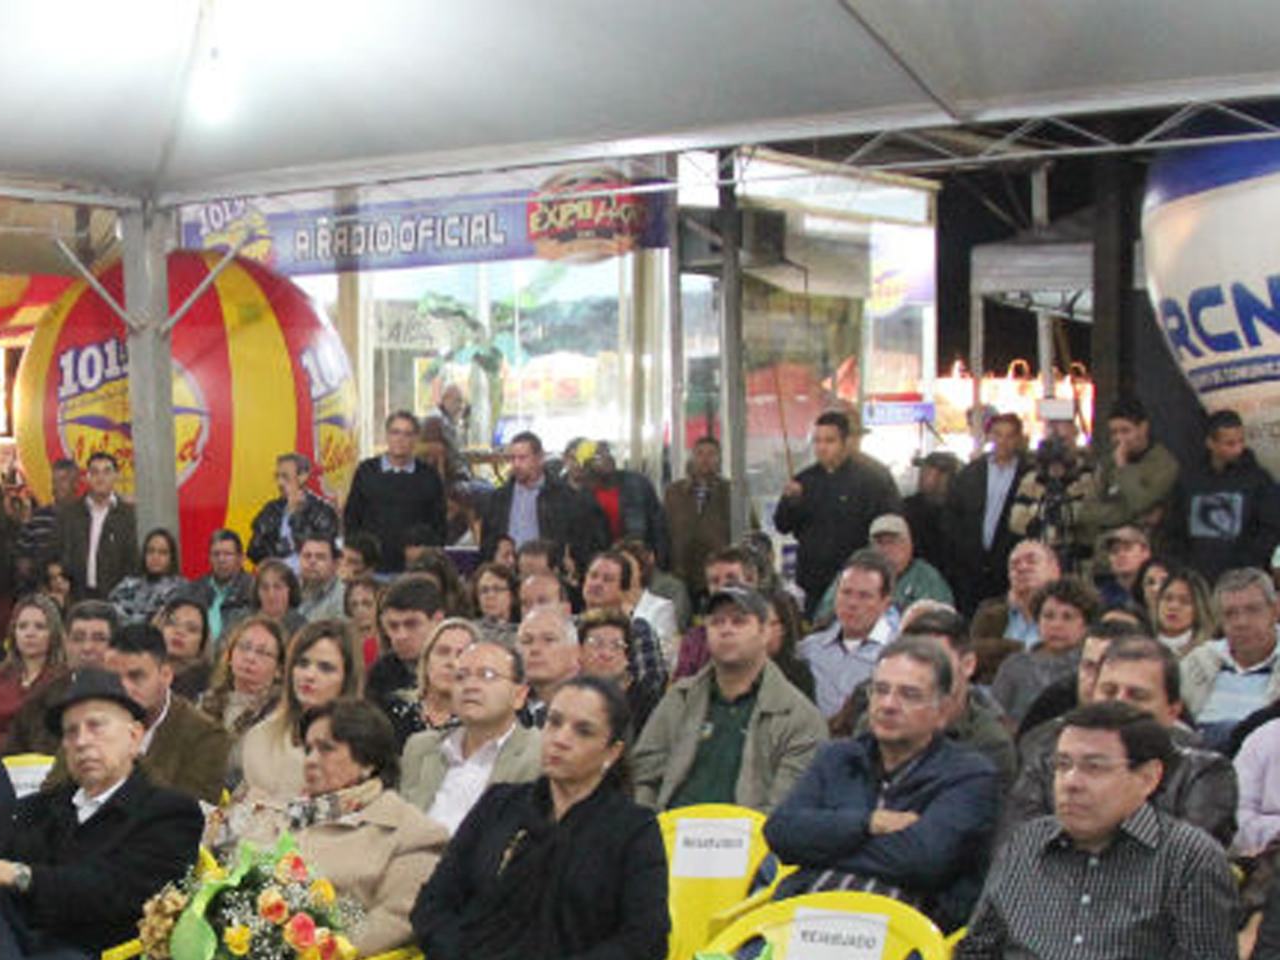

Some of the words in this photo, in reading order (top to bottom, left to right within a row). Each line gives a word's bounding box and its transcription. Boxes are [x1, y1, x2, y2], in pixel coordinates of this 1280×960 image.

[293, 228, 310, 260] A
[399, 211, 505, 252] OFICIAL
[1158, 274, 1280, 359] RCN
